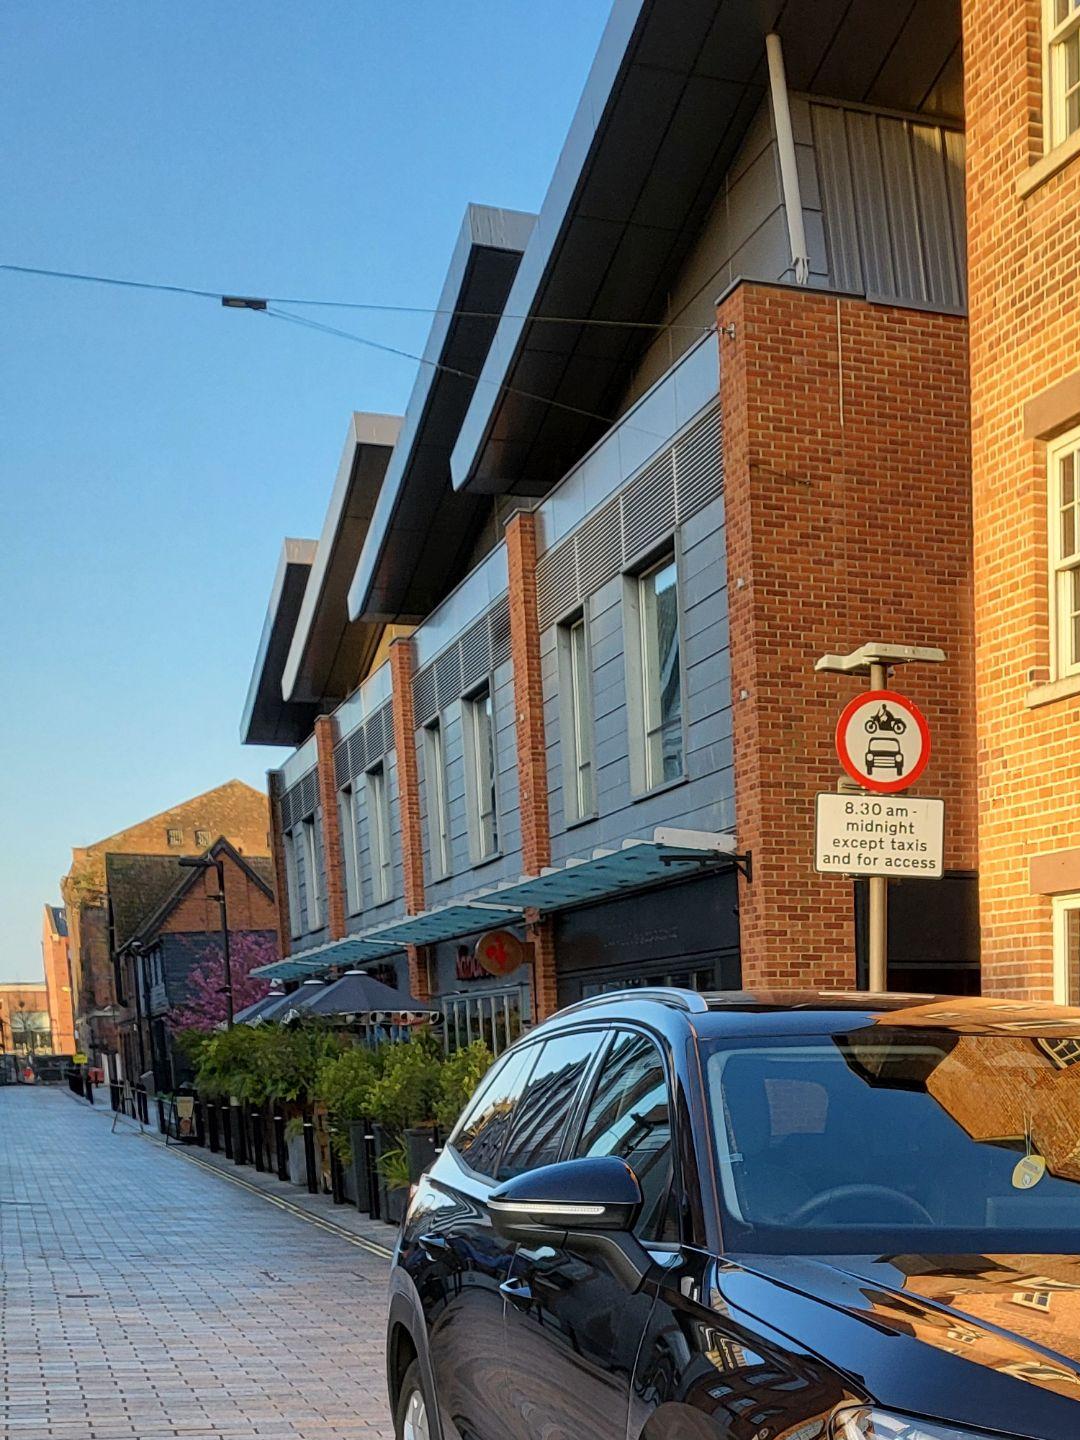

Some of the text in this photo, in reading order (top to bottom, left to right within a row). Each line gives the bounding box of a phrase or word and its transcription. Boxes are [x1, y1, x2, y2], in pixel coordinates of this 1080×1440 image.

[845, 801, 882, 817] 8.30
[886, 804, 908, 817] am
[846, 820, 915, 836] midnight
[832, 836, 928, 852] except taxis
[823, 852, 937, 869] and for access
